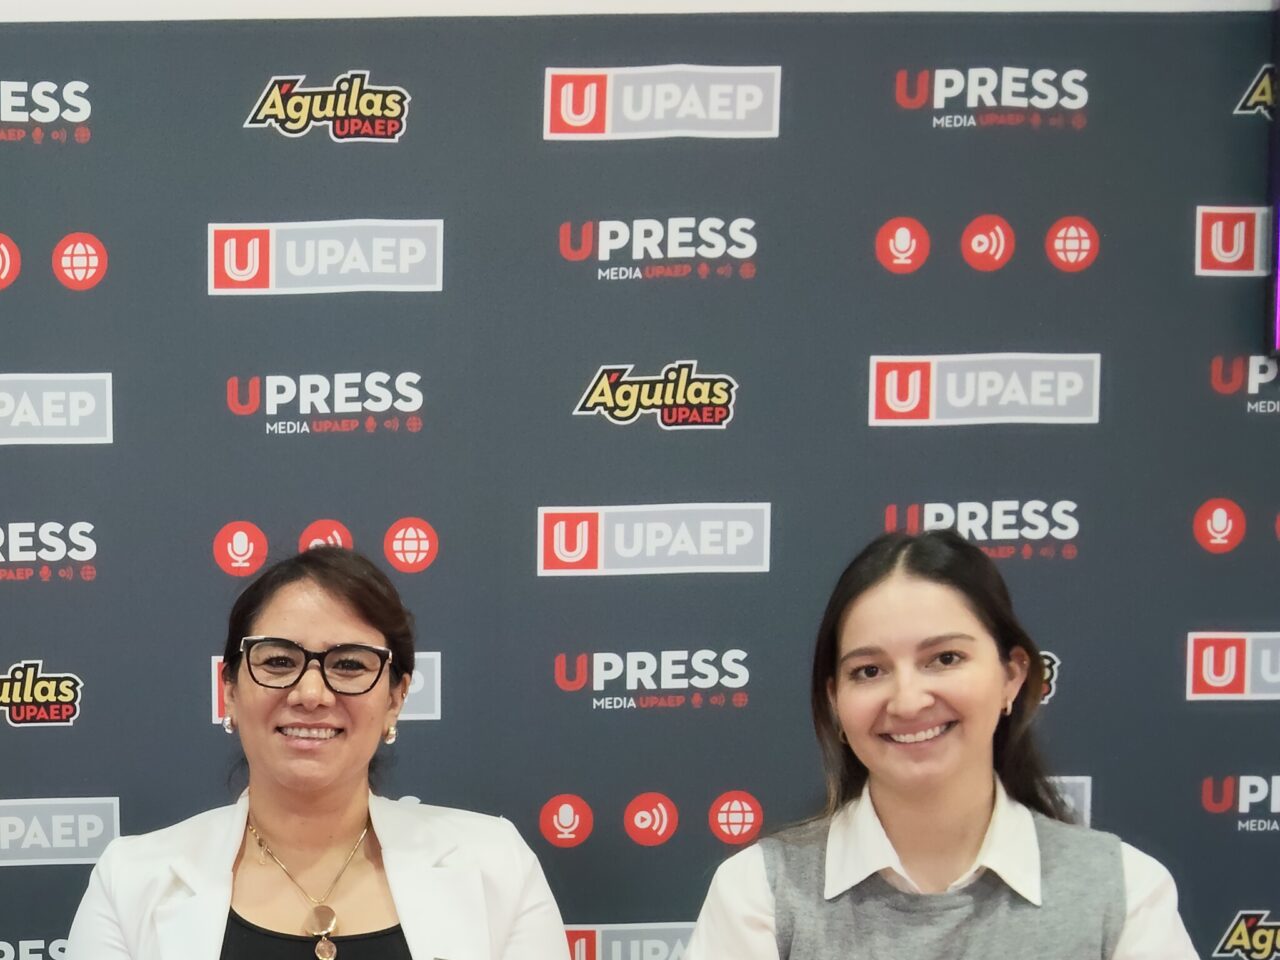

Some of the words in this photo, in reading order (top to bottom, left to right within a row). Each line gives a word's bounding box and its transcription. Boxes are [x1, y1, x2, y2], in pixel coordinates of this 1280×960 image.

[259, 79, 401, 129] Águilas
[561, 83, 596, 126] U
[623, 84, 763, 121] UPAEP
[895, 67, 1088, 109] UPRESS
[334, 117, 400, 137] UPAEP
[933, 115, 976, 127] MEDIA
[559, 217, 757, 261] UPRESS
[1212, 222, 1244, 262] U
[224, 238, 259, 281] U
[287, 238, 426, 275] UPAEP
[598, 267, 642, 280] MEDIA
[643, 264, 691, 278] UPAEP
[226, 371, 423, 416] UPRESS
[587, 368, 728, 417] Águilas
[885, 370, 921, 412] U
[947, 372, 1083, 407] UPAEP
[1247, 400, 1280, 413] MEDI
[266, 421, 310, 434] MEDIA
[311, 419, 359, 432] UPAEP
[661, 405, 728, 424] UPAEP
[554, 521, 588, 562] U
[615, 521, 753, 557] UPAEP
[554, 649, 749, 692] UPRESS
[1203, 646, 1236, 686] U
[11, 703, 75, 721] UPAEP
[593, 697, 636, 709] MEDIA
[637, 695, 685, 708] UPAEP
[1237, 819, 1280, 832] MEDIA
